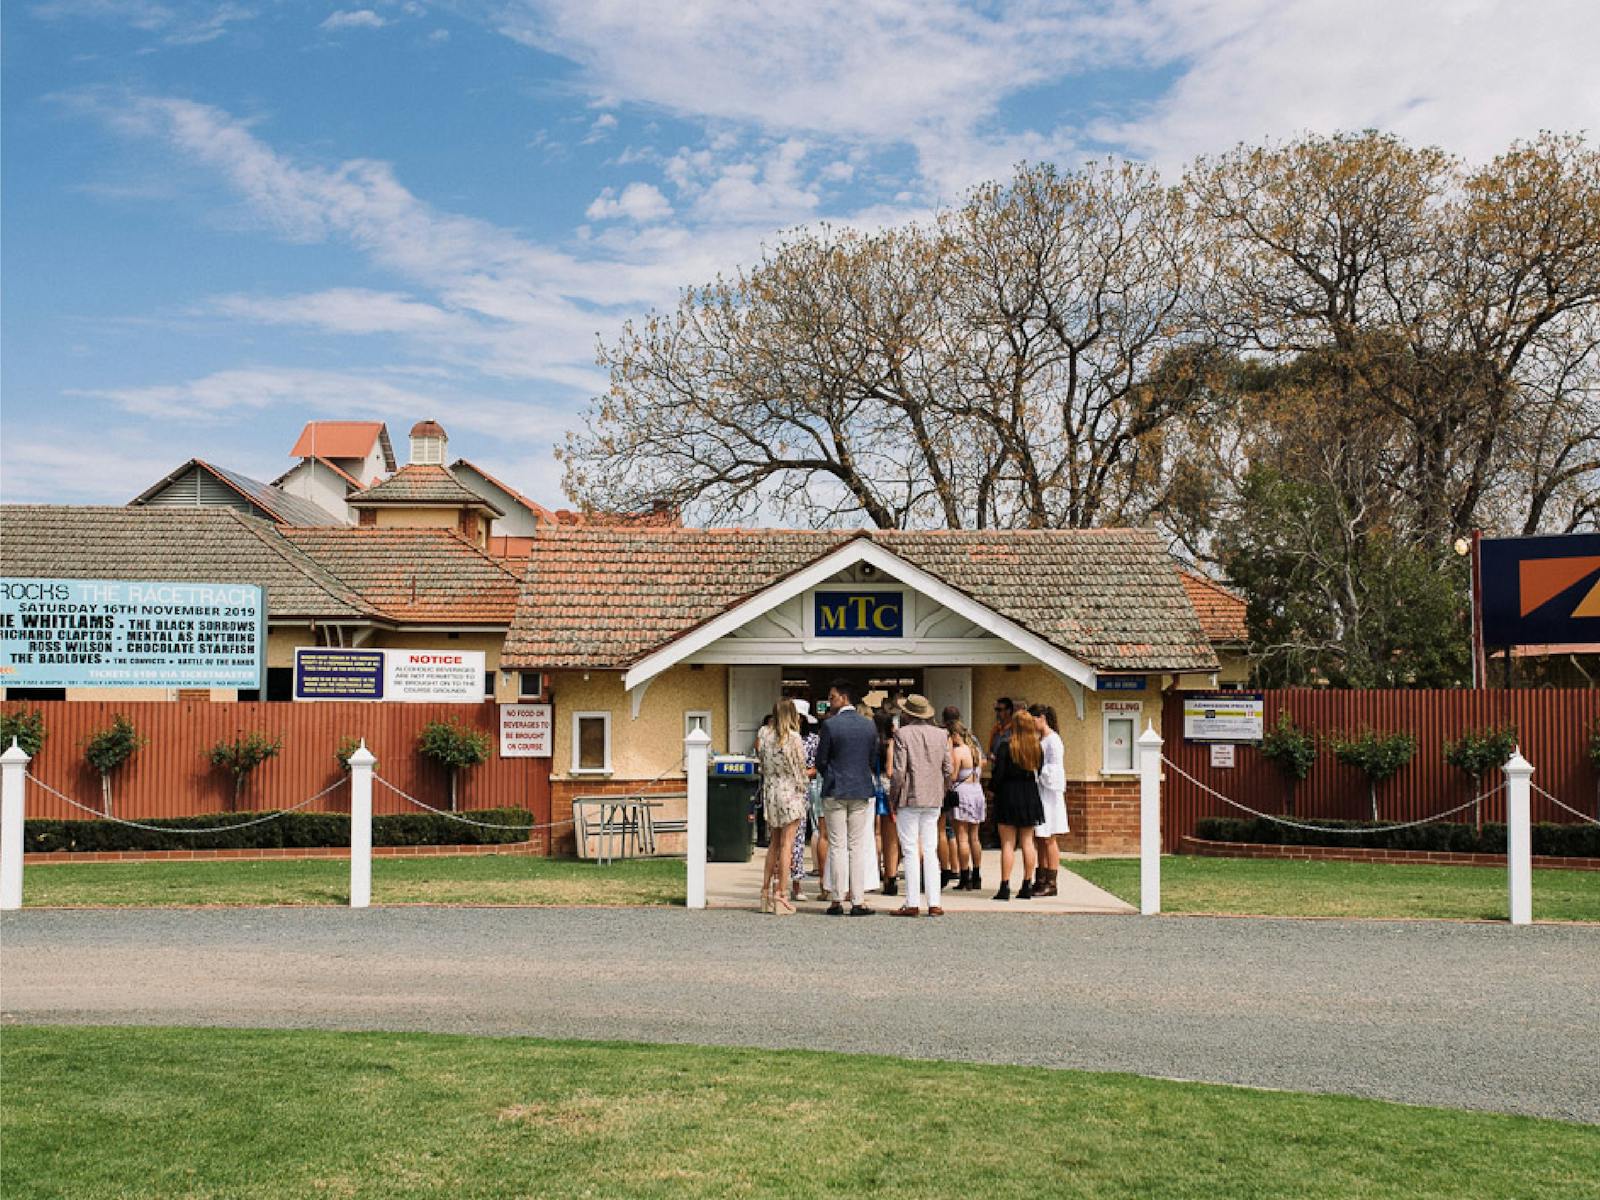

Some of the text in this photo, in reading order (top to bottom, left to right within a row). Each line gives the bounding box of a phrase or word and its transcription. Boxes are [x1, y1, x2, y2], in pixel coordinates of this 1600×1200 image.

[0, 583, 256, 607] ROCKS THE RACETRACK
[18, 602, 255, 617] SATURDAY 16TH NOVEMBER 2019
[820, 596, 898, 631] MTC
[21, 614, 114, 629] WHITLAMS
[128, 619, 151, 631] THE
[156, 620, 194, 632] BLACK
[199, 621, 255, 632] SORROWS
[57, 630, 113, 641] CLAPTON
[126, 631, 173, 642] MENTAL
[177, 632, 194, 642] AS
[197, 633, 255, 643] ANYTHING
[29, 641, 255, 654] ROSS WILSON CHOCOLATE STARFISH
[10, 653, 34, 664] THE
[38, 653, 103, 664] BADLOVES
[409, 655, 463, 665] NOTICE
[1104, 702, 1140, 711] SELLING
[503, 721, 540, 729] BEVERAGES
[506, 743, 544, 751] ON COURSE
[723, 763, 746, 773] FREE
